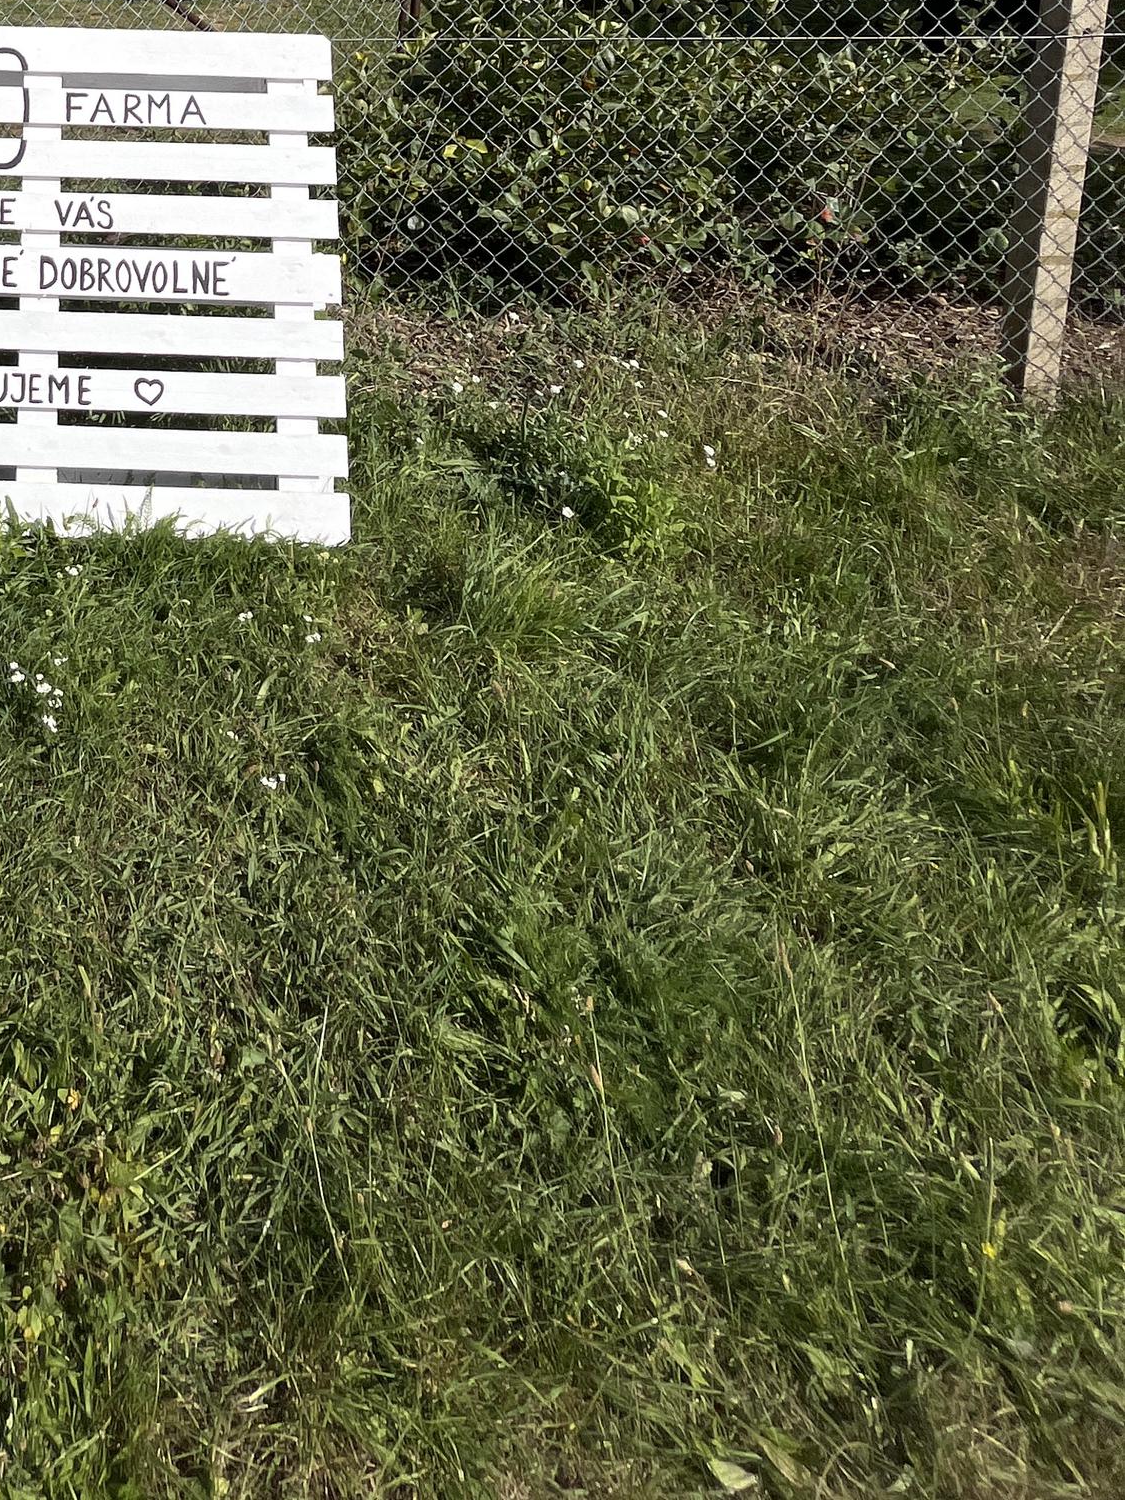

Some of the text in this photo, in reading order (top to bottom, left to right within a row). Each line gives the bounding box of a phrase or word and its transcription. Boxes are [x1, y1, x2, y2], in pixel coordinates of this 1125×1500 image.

[65, 93, 207, 125] FARMA
[54, 197, 114, 229] VÁS
[39, 256, 236, 296] DOBROVOLNÉ
